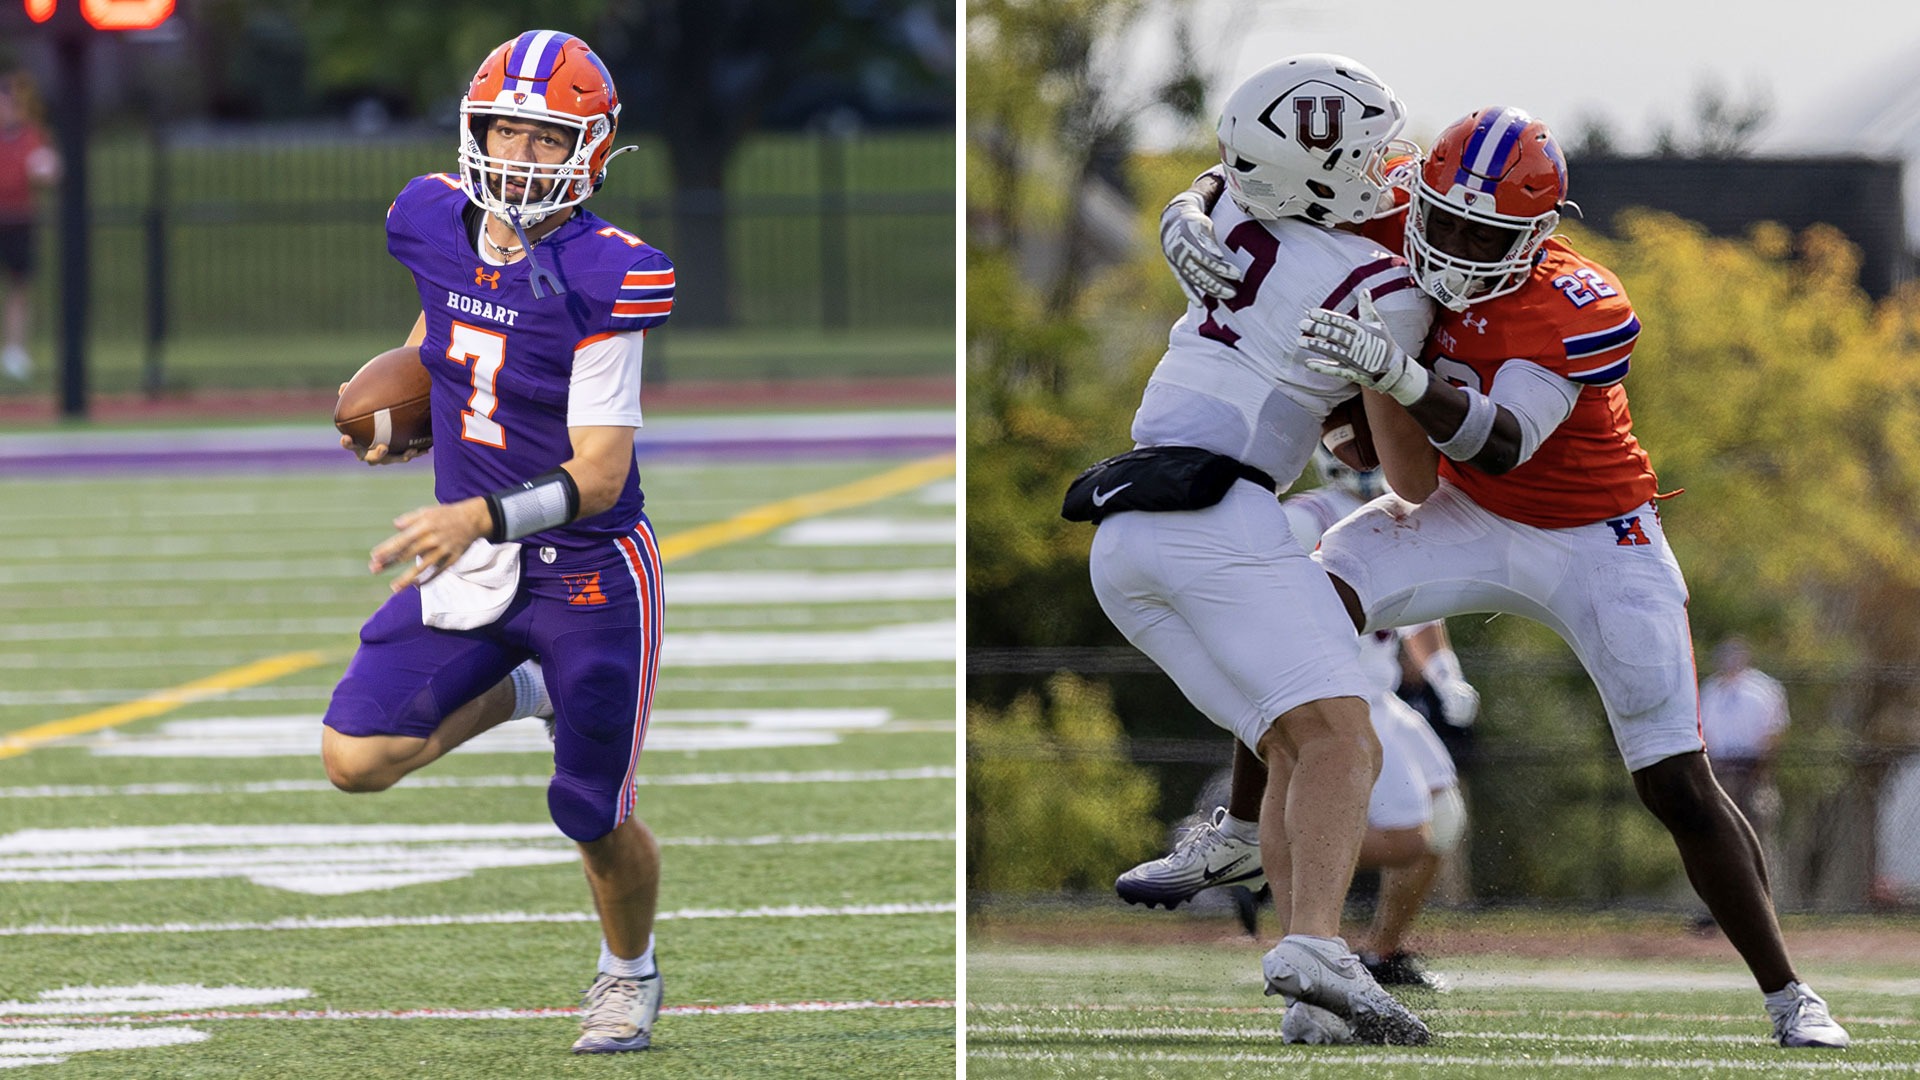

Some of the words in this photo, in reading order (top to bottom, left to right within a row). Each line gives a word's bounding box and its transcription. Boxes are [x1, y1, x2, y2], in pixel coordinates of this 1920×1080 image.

[1293, 96, 1345, 153] U
[447, 291, 519, 327] HOBART
[1552, 267, 1618, 309] 22
[445, 320, 507, 450] 7
